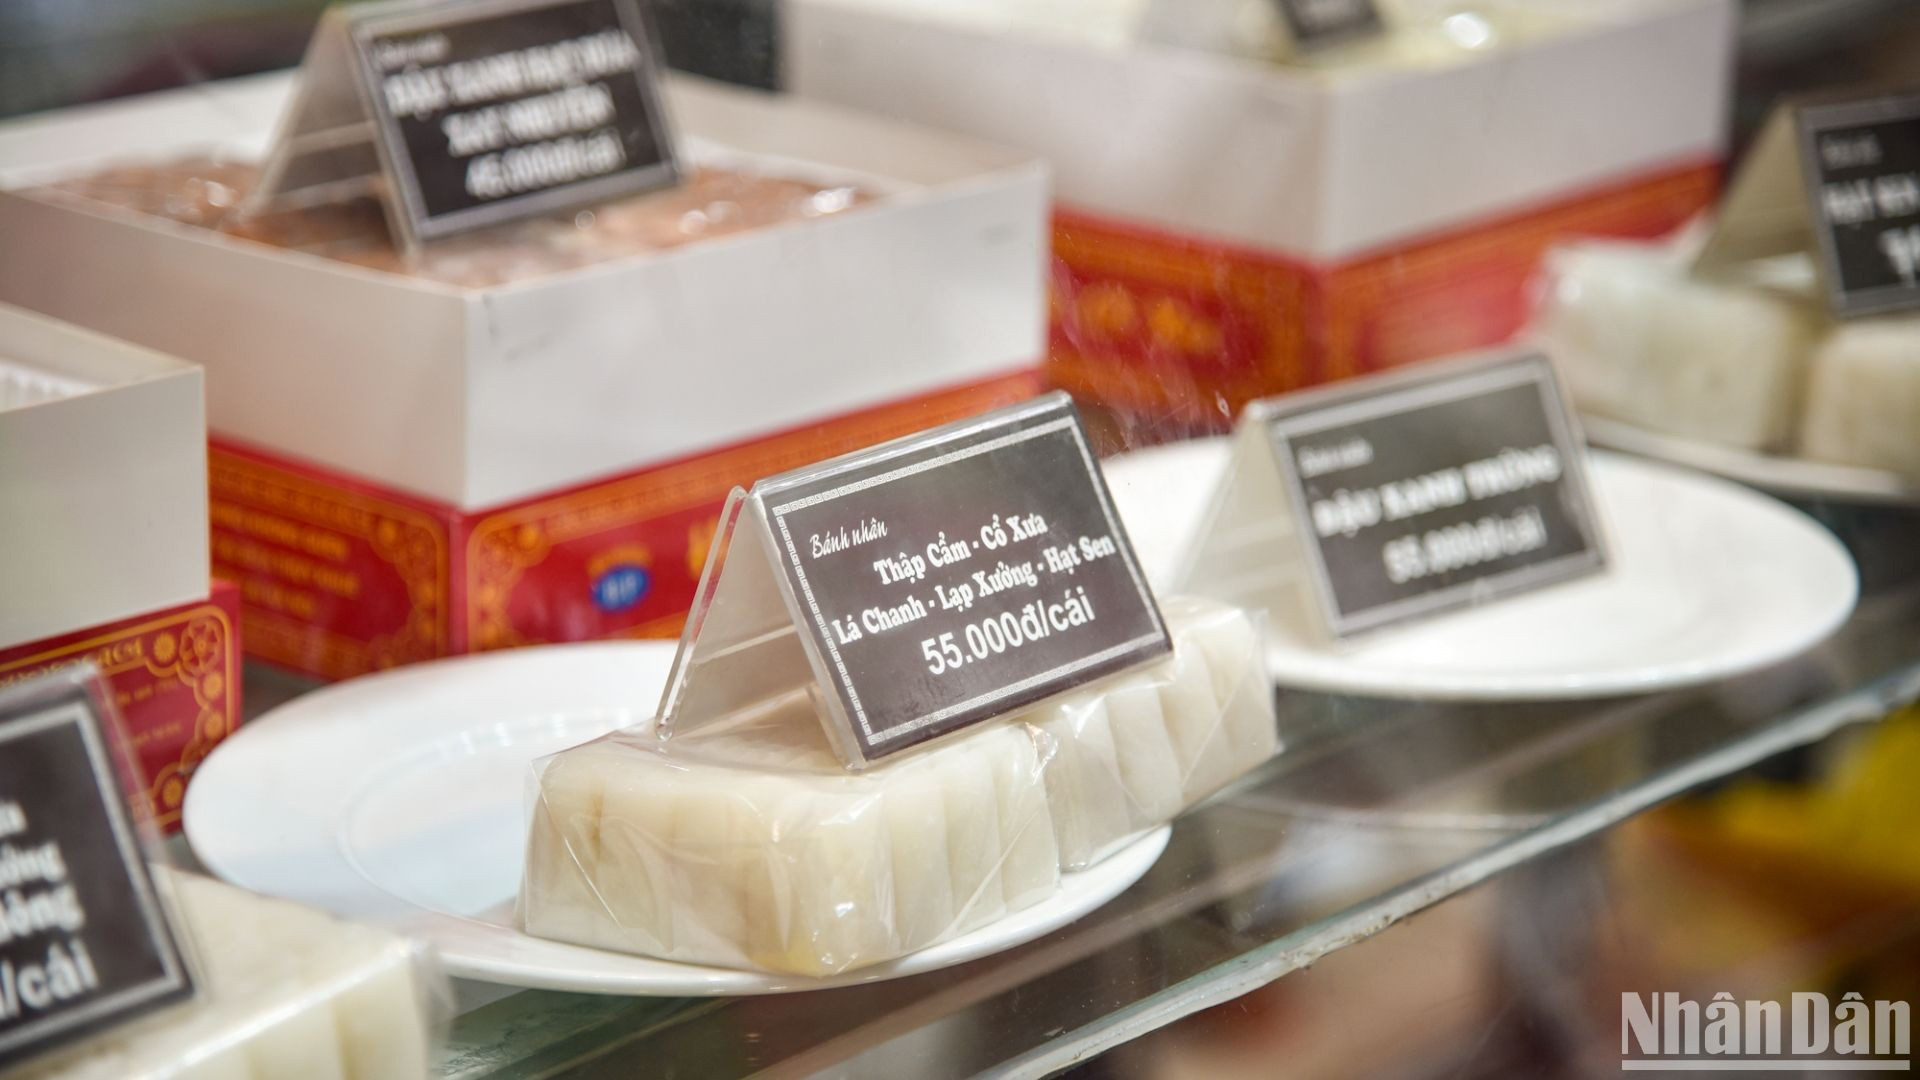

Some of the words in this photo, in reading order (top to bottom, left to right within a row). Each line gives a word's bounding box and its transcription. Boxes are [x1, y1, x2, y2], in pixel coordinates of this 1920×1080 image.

[810, 526, 850, 559] Bánh
[852, 517, 888, 546] nhân
[873, 552, 926, 584] Thập
[927, 531, 972, 568] Cẩm
[980, 514, 1008, 550] Cổ
[1006, 512, 1049, 543] Xưa
[831, 614, 863, 644] Lá
[862, 595, 928, 634] Chanh
[934, 585, 974, 612] Lạp
[972, 561, 1038, 598] Xưởng
[1043, 543, 1082, 575] Hạt
[1079, 535, 1116, 561] Sen
[921, 586, 1096, 675] 55.000đ/cái
